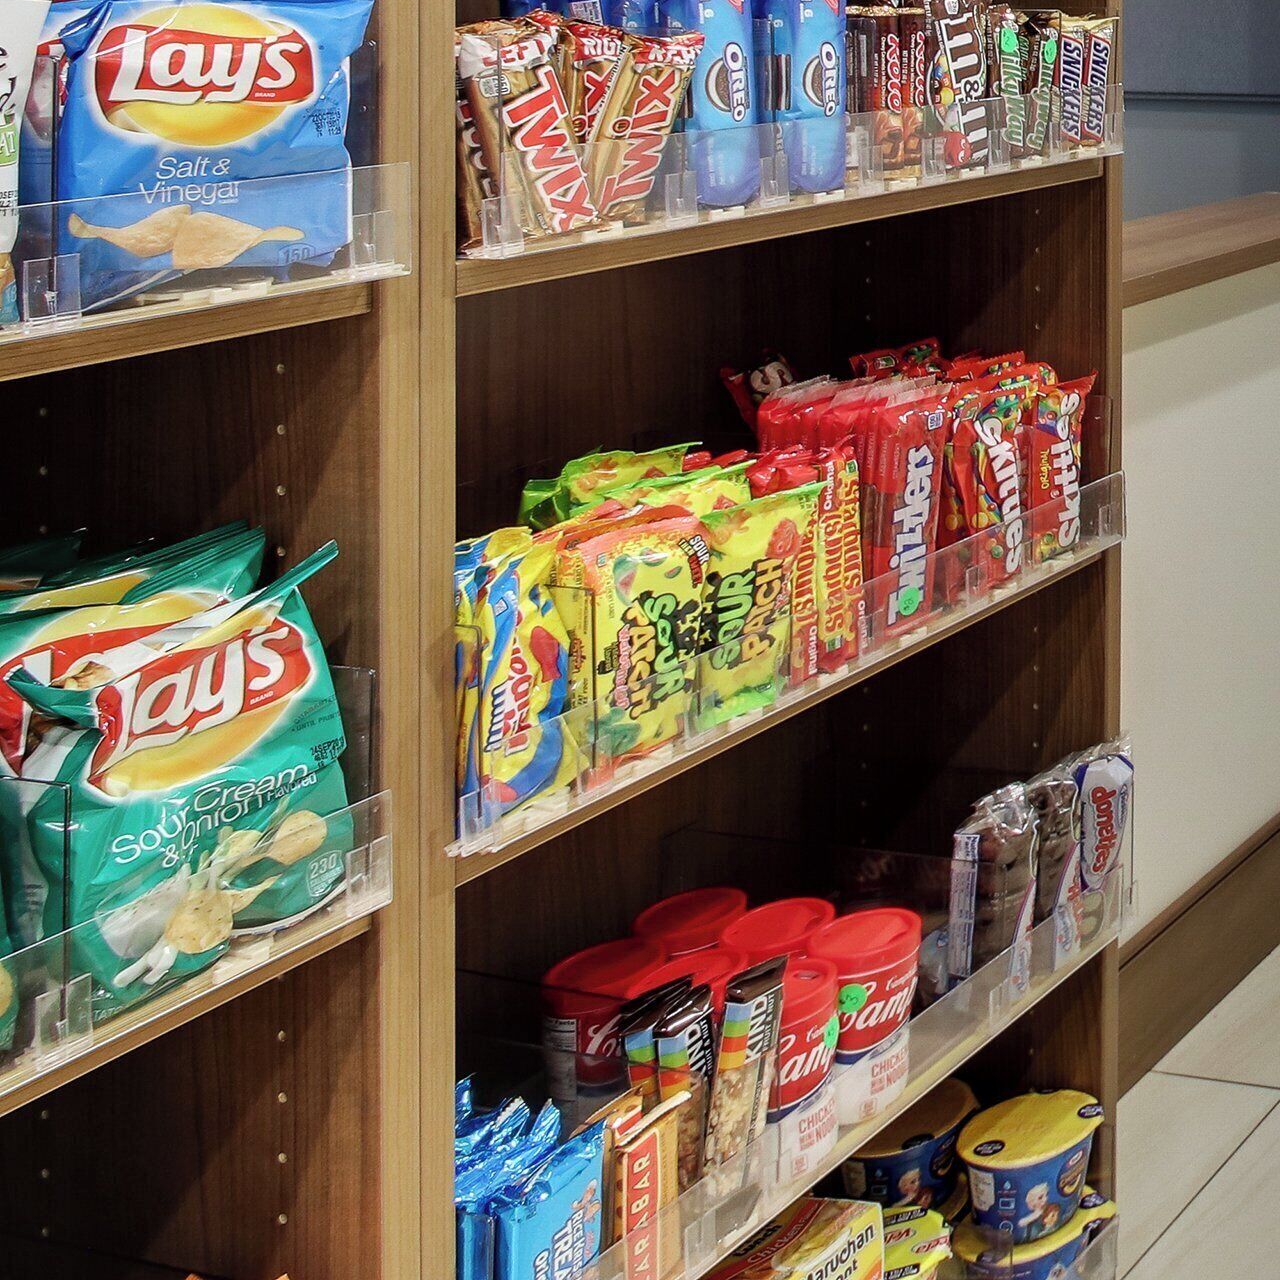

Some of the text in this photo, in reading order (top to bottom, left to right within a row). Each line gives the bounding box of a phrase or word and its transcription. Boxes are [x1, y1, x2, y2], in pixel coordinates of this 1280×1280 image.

[107, 26, 303, 104] Lay's
[723, 41, 747, 123] OREO
[819, 41, 838, 118] OREO
[1062, 39, 1084, 141] SNICKERS
[1086, 38, 1110, 137] SNICKERS
[155, 156, 231, 180] Salt &
[503, 68, 597, 232] TWIX
[600, 69, 682, 216] TWIX
[139, 181, 239, 205] Vinegar
[711, 568, 756, 670] SOUR
[741, 556, 785, 662] PATCH
[117, 619, 292, 755] Lay's
[112, 764, 308, 864] Sour Cream
[161, 842, 180, 869] &
[1091, 786, 1118, 873] donettes
[745, 994, 768, 1063] KIND
[805, 1223, 875, 1280] aruchan
